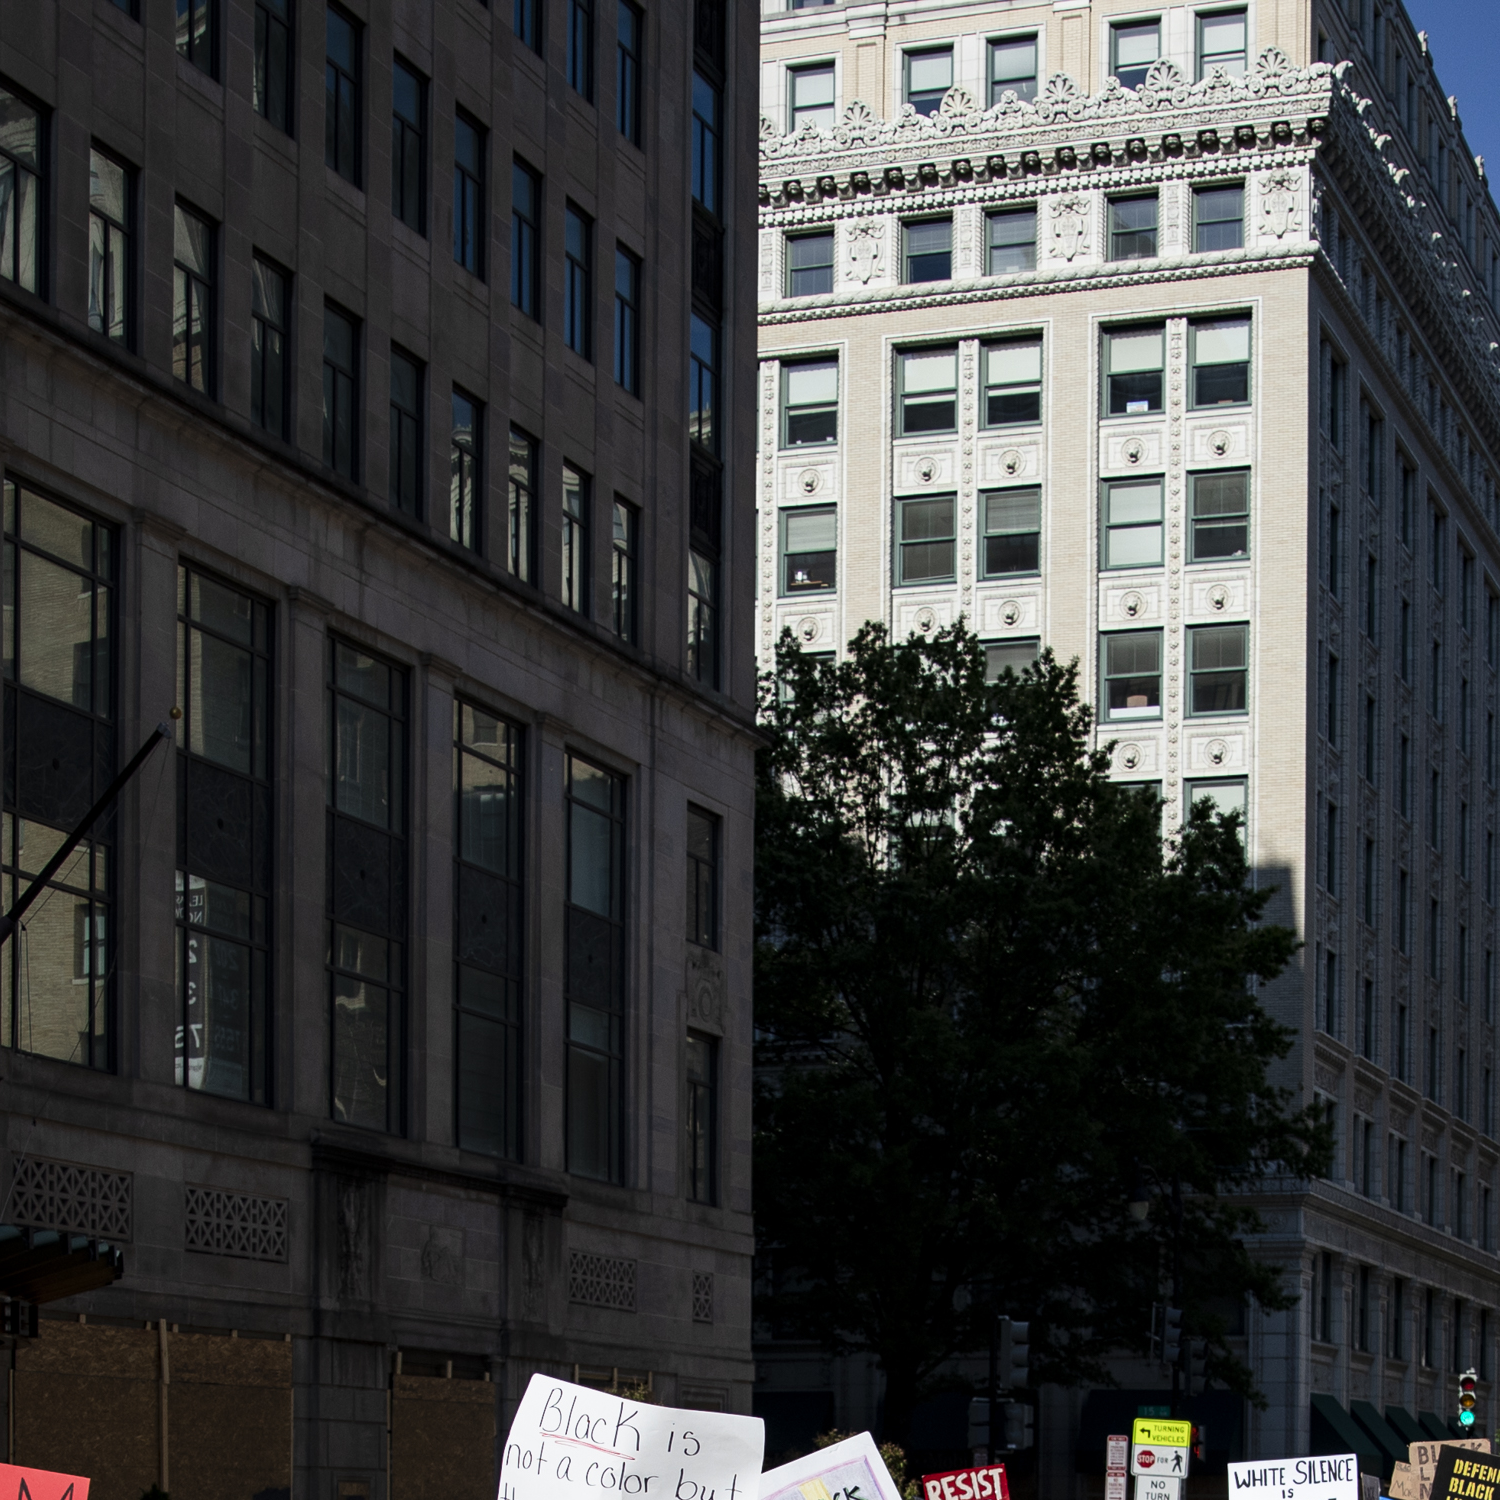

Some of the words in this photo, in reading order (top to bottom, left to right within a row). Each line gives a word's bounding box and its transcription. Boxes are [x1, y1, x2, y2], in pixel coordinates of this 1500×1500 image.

[539, 1387, 640, 1451] Black
[668, 1422, 700, 1456] is
[1154, 1425, 1185, 1433] TURNING
[1152, 1435, 1185, 1443] VEHICLES
[1137, 1454, 1155, 1464] STOP
[506, 1442, 548, 1476] not
[556, 1456, 573, 1482] a
[586, 1462, 658, 1494] color
[1234, 1467, 1285, 1489] WHITE
[1293, 1458, 1354, 1485] SILENCE
[1151, 1481, 1166, 1489] NO
[1145, 1492, 1170, 1500] TURN
[1282, 1489, 1294, 1499] IS
